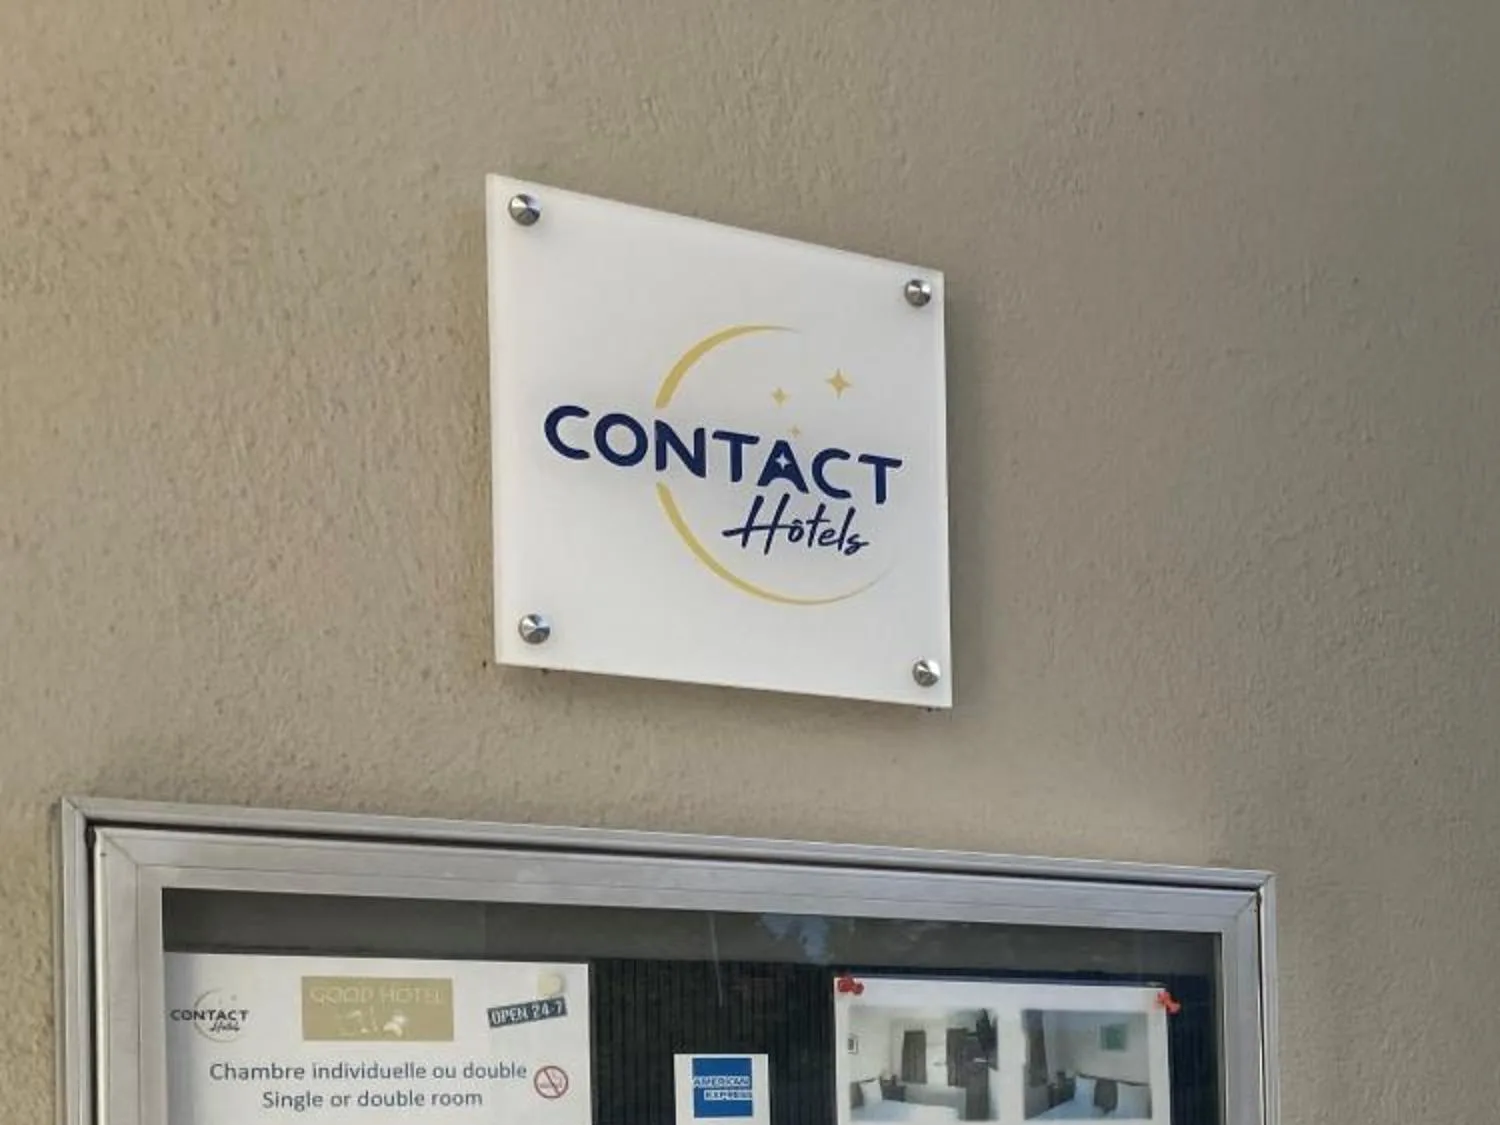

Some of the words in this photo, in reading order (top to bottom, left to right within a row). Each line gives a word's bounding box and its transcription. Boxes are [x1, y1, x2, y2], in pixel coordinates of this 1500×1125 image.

[544, 404, 902, 505] CONTACT
[723, 493, 869, 556] Hôtels
[170, 1009, 250, 1021] CONTACT
[491, 1007, 528, 1025] OPEN
[210, 1063, 305, 1080] Chambre
[312, 1062, 427, 1079] individuelle
[432, 1066, 456, 1079] ou
[463, 1062, 527, 1079] double
[262, 1091, 323, 1111] Single
[330, 1093, 350, 1107] or
[357, 1090, 424, 1107] double
[431, 1093, 483, 1107] room
